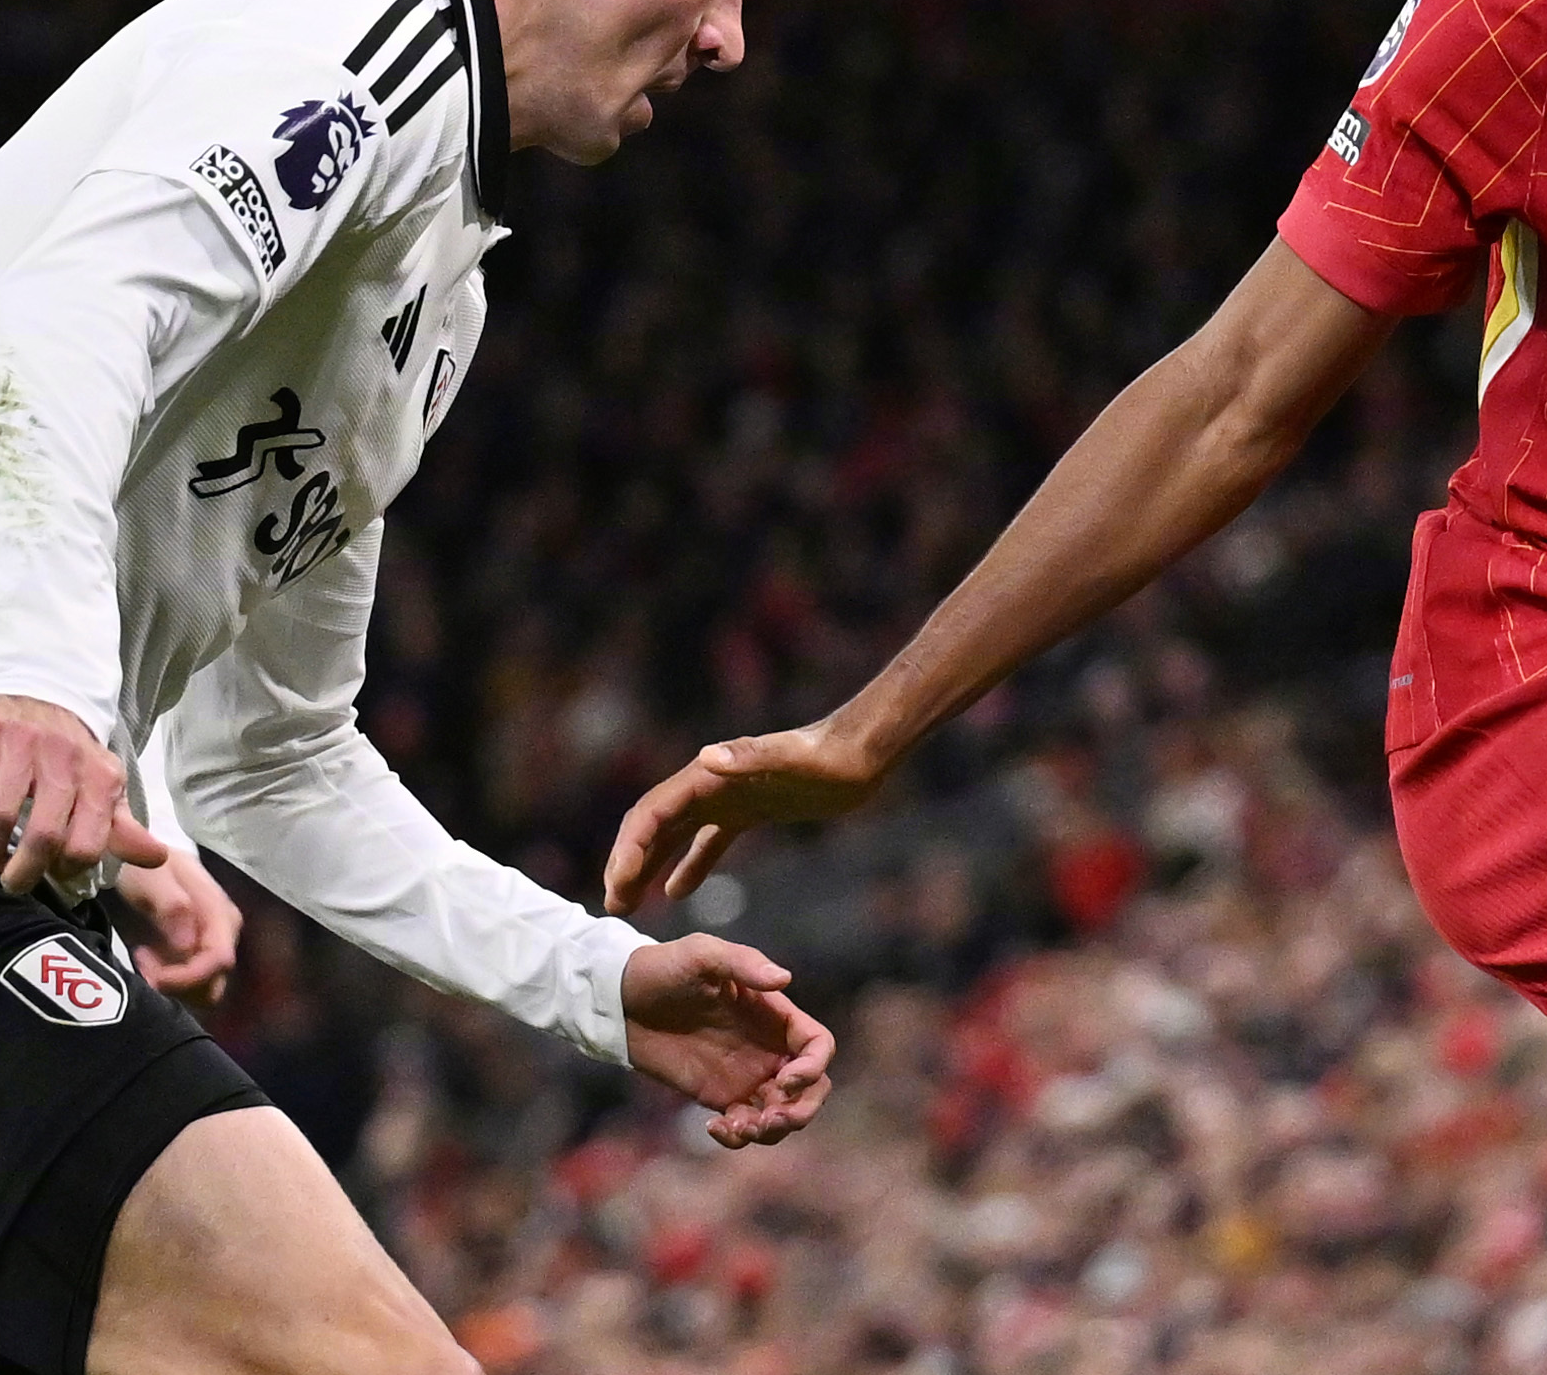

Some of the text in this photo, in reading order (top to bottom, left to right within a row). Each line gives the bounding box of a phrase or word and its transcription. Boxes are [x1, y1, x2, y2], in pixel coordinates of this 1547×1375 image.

[190, 158, 274, 281] for racism
[202, 145, 279, 257] No room
[41, 954, 103, 1009] FFC
